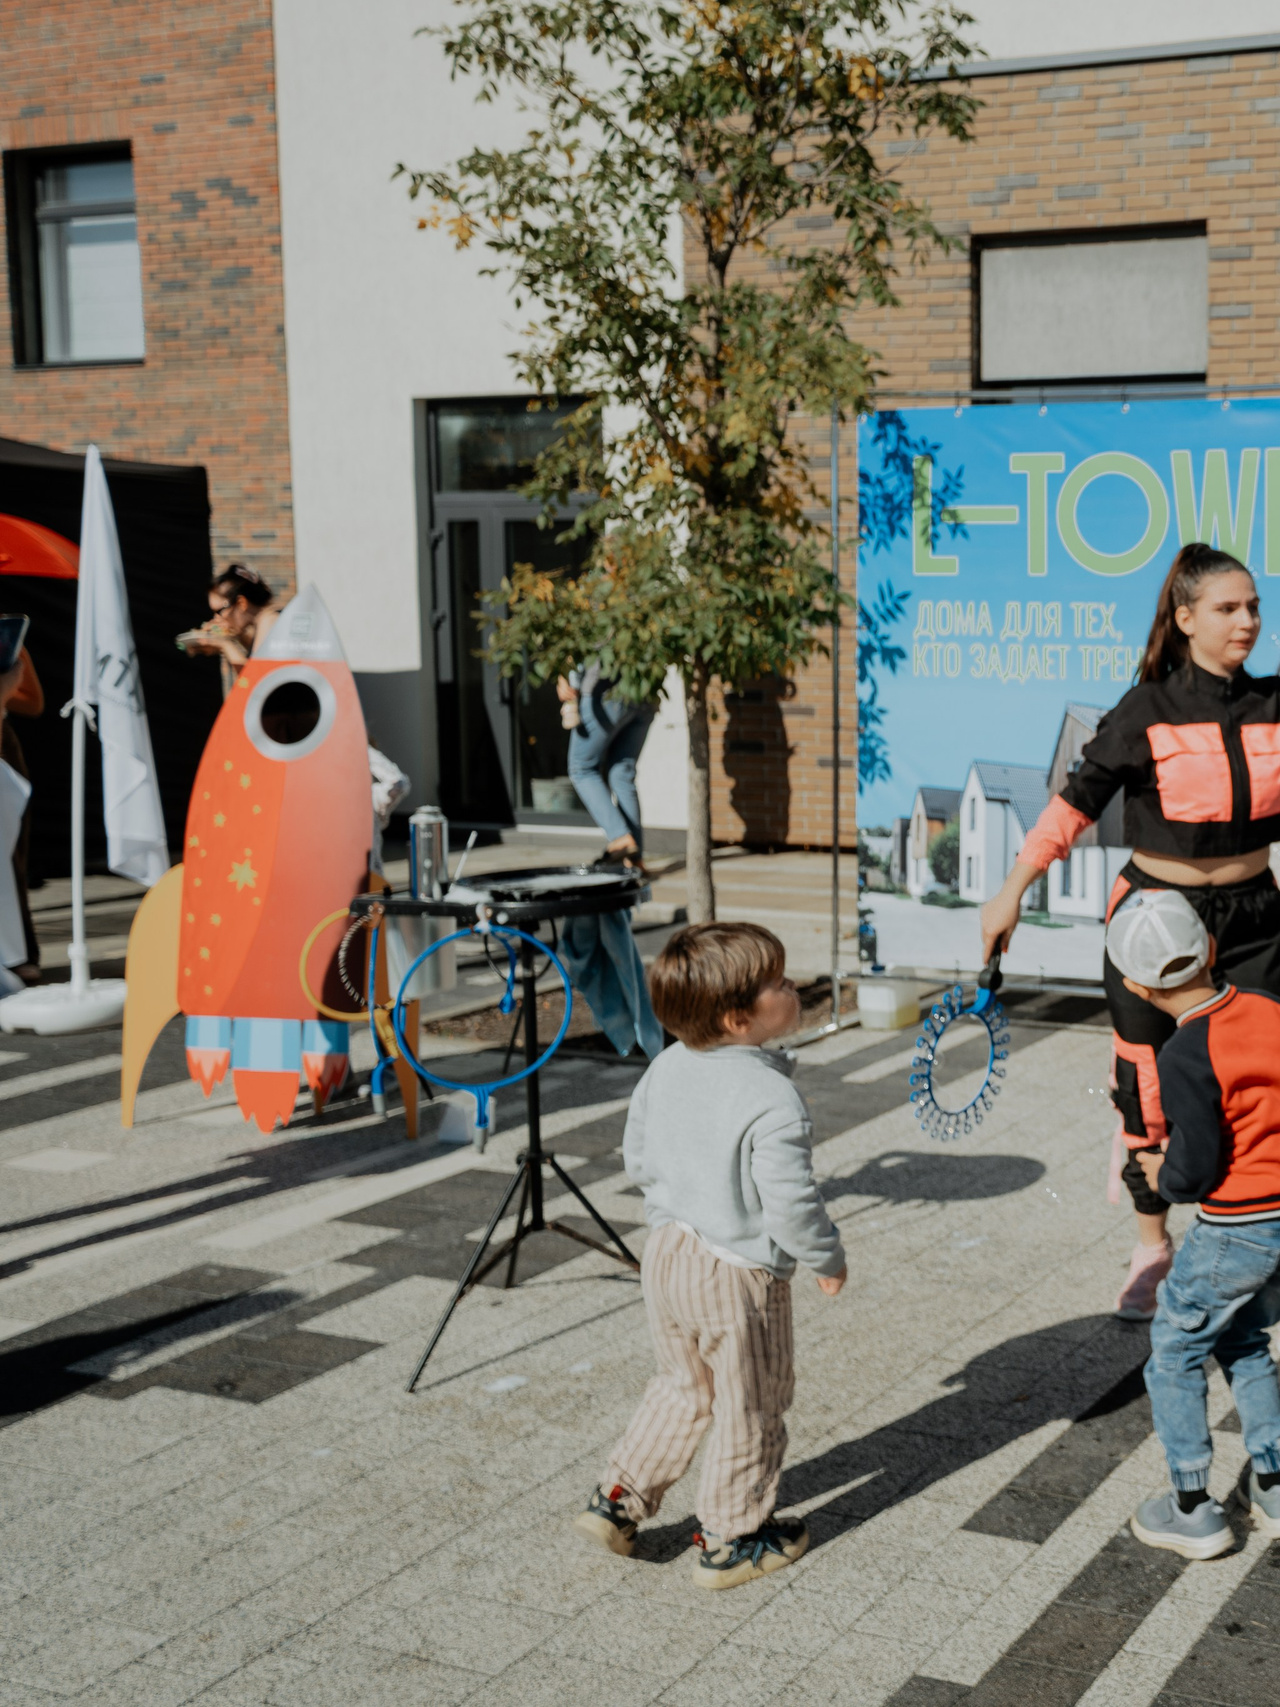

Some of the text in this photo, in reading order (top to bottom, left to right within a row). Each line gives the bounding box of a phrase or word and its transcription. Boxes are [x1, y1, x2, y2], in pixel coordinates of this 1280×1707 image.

[914, 600, 1123, 643] ДОМА ДЛЯ ТЕХ,
[912, 642, 961, 677] КТО
[970, 642, 1067, 683] ЗАДАЕТ
